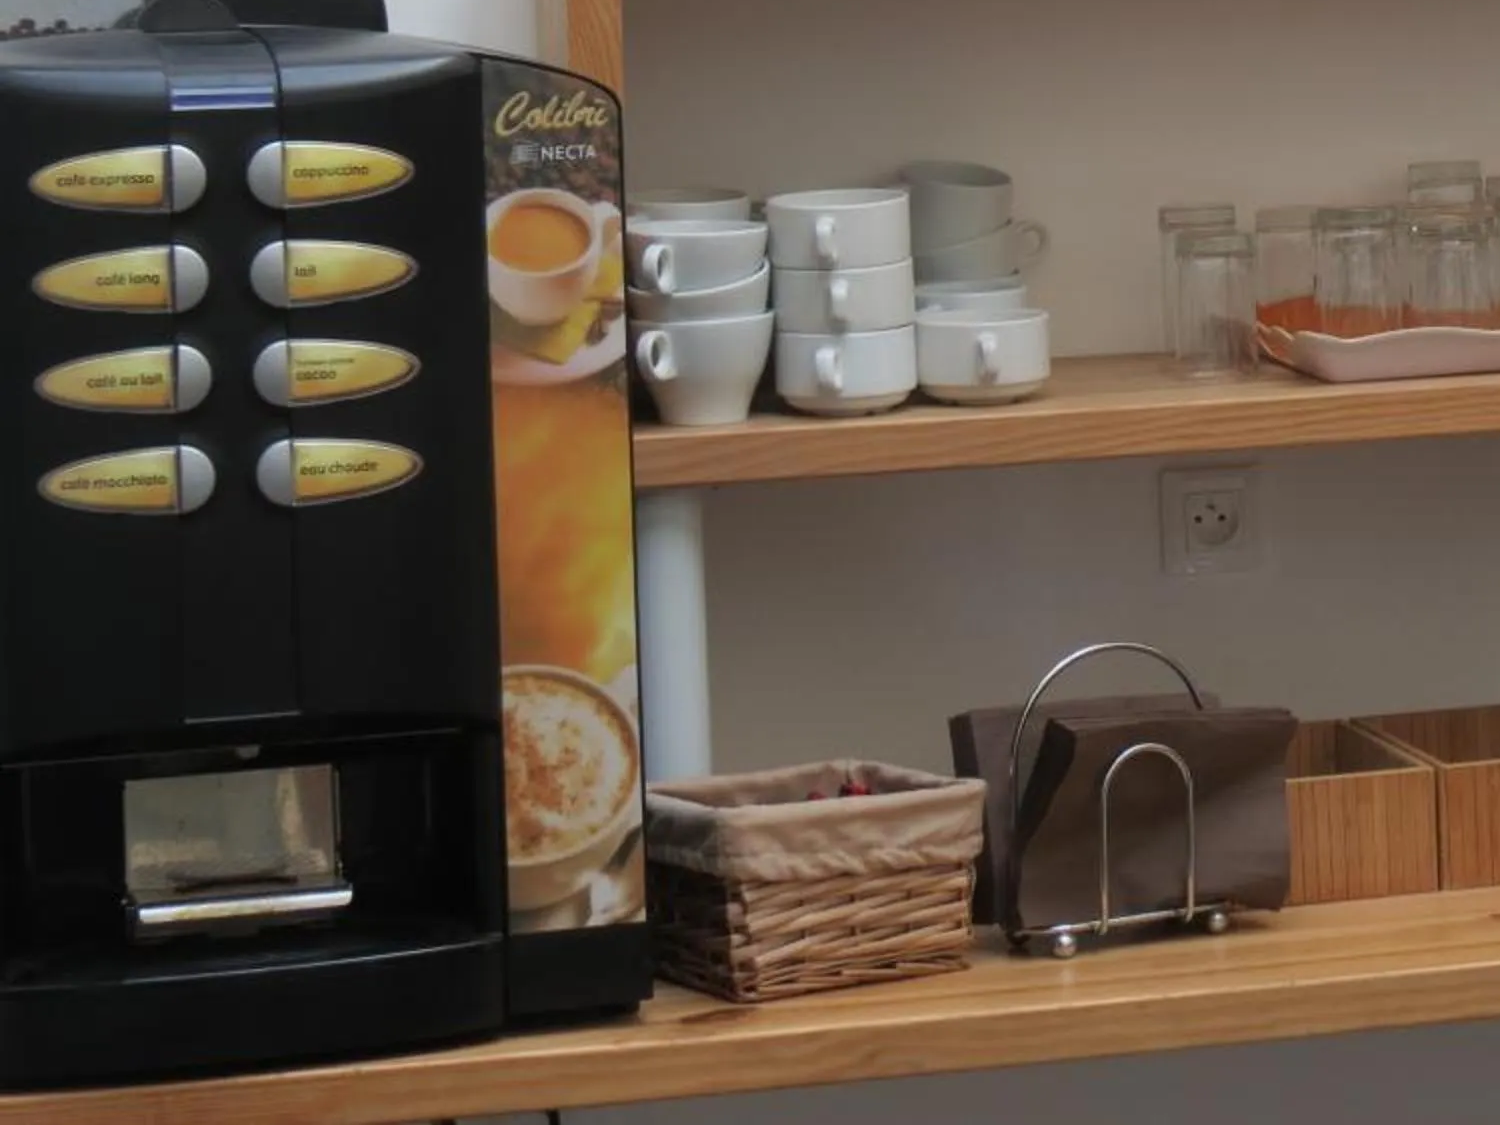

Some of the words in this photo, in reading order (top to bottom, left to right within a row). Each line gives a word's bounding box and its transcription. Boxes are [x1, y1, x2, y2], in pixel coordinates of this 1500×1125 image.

[541, 144, 596, 162] NECTA
[128, 273, 160, 286] long
[300, 464, 326, 476] eau
[328, 460, 379, 474] chaude
